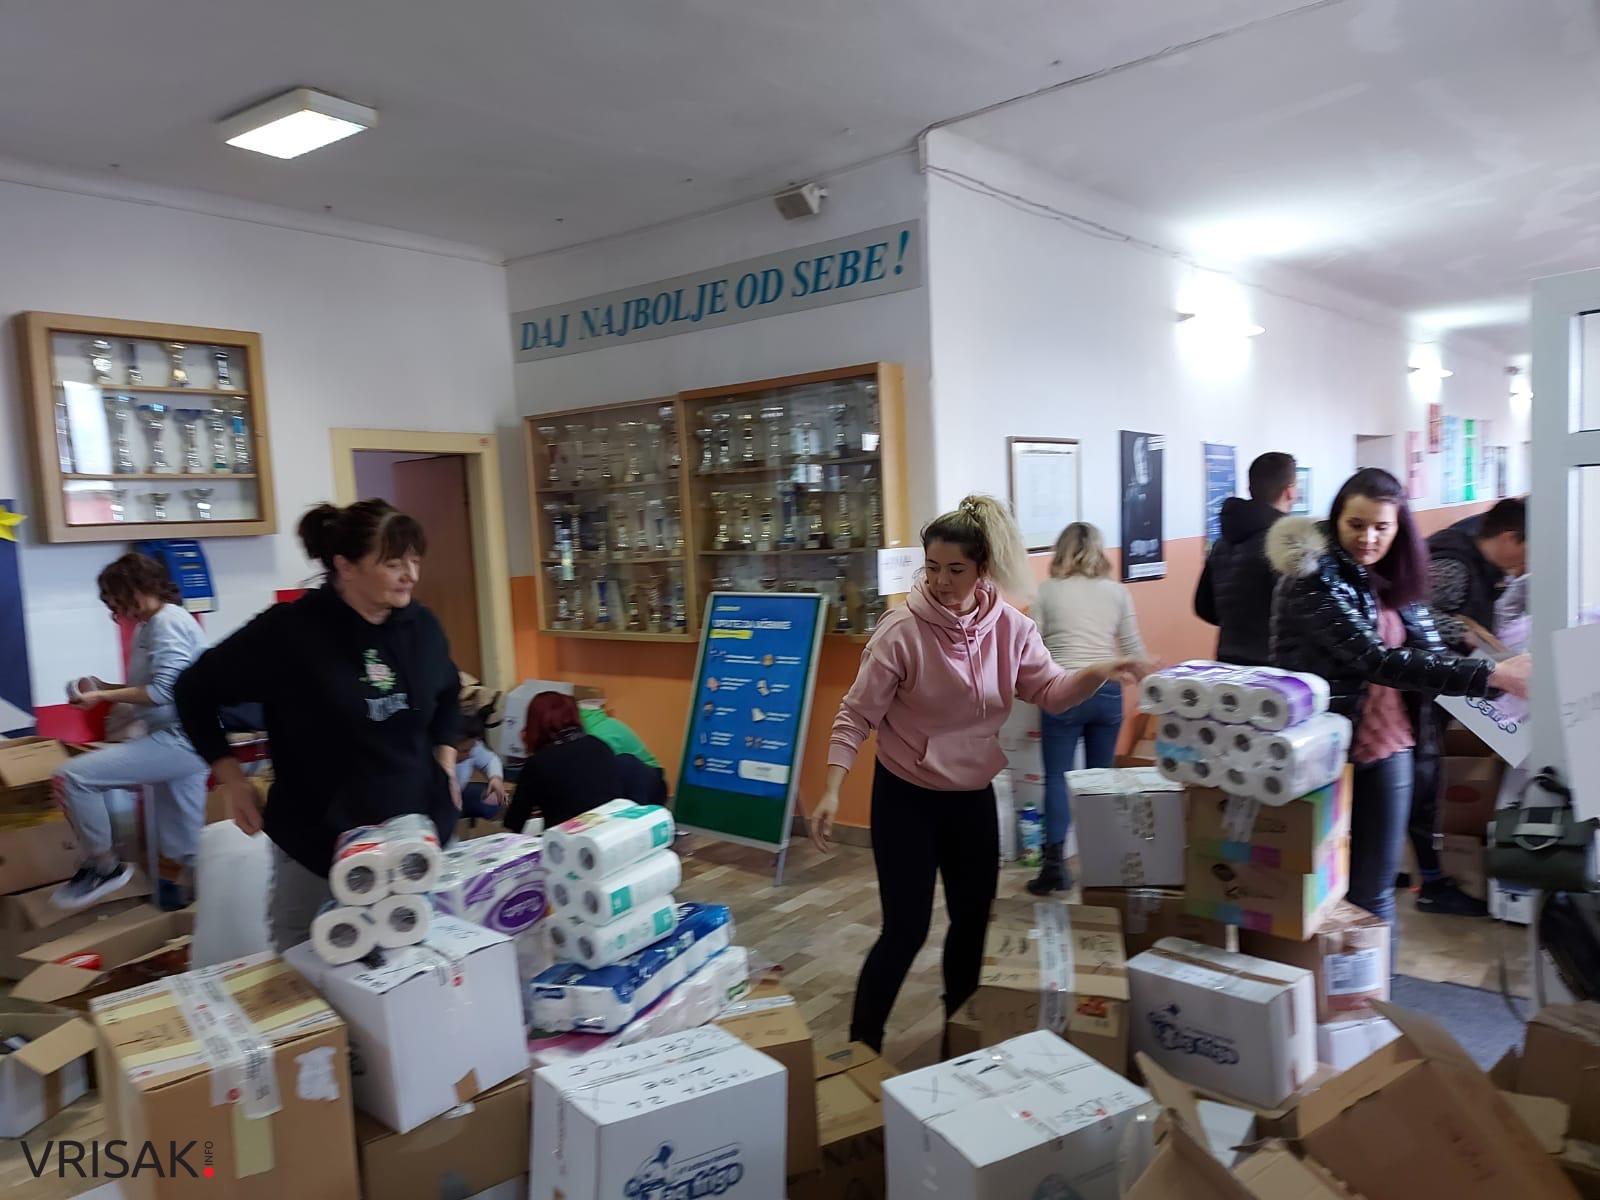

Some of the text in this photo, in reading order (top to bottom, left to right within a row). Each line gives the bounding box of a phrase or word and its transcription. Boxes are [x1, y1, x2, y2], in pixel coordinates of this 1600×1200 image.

[520, 314, 570, 351] DAJ
[578, 279, 729, 341] NAJBOLJE
[735, 268, 784, 310] OD
